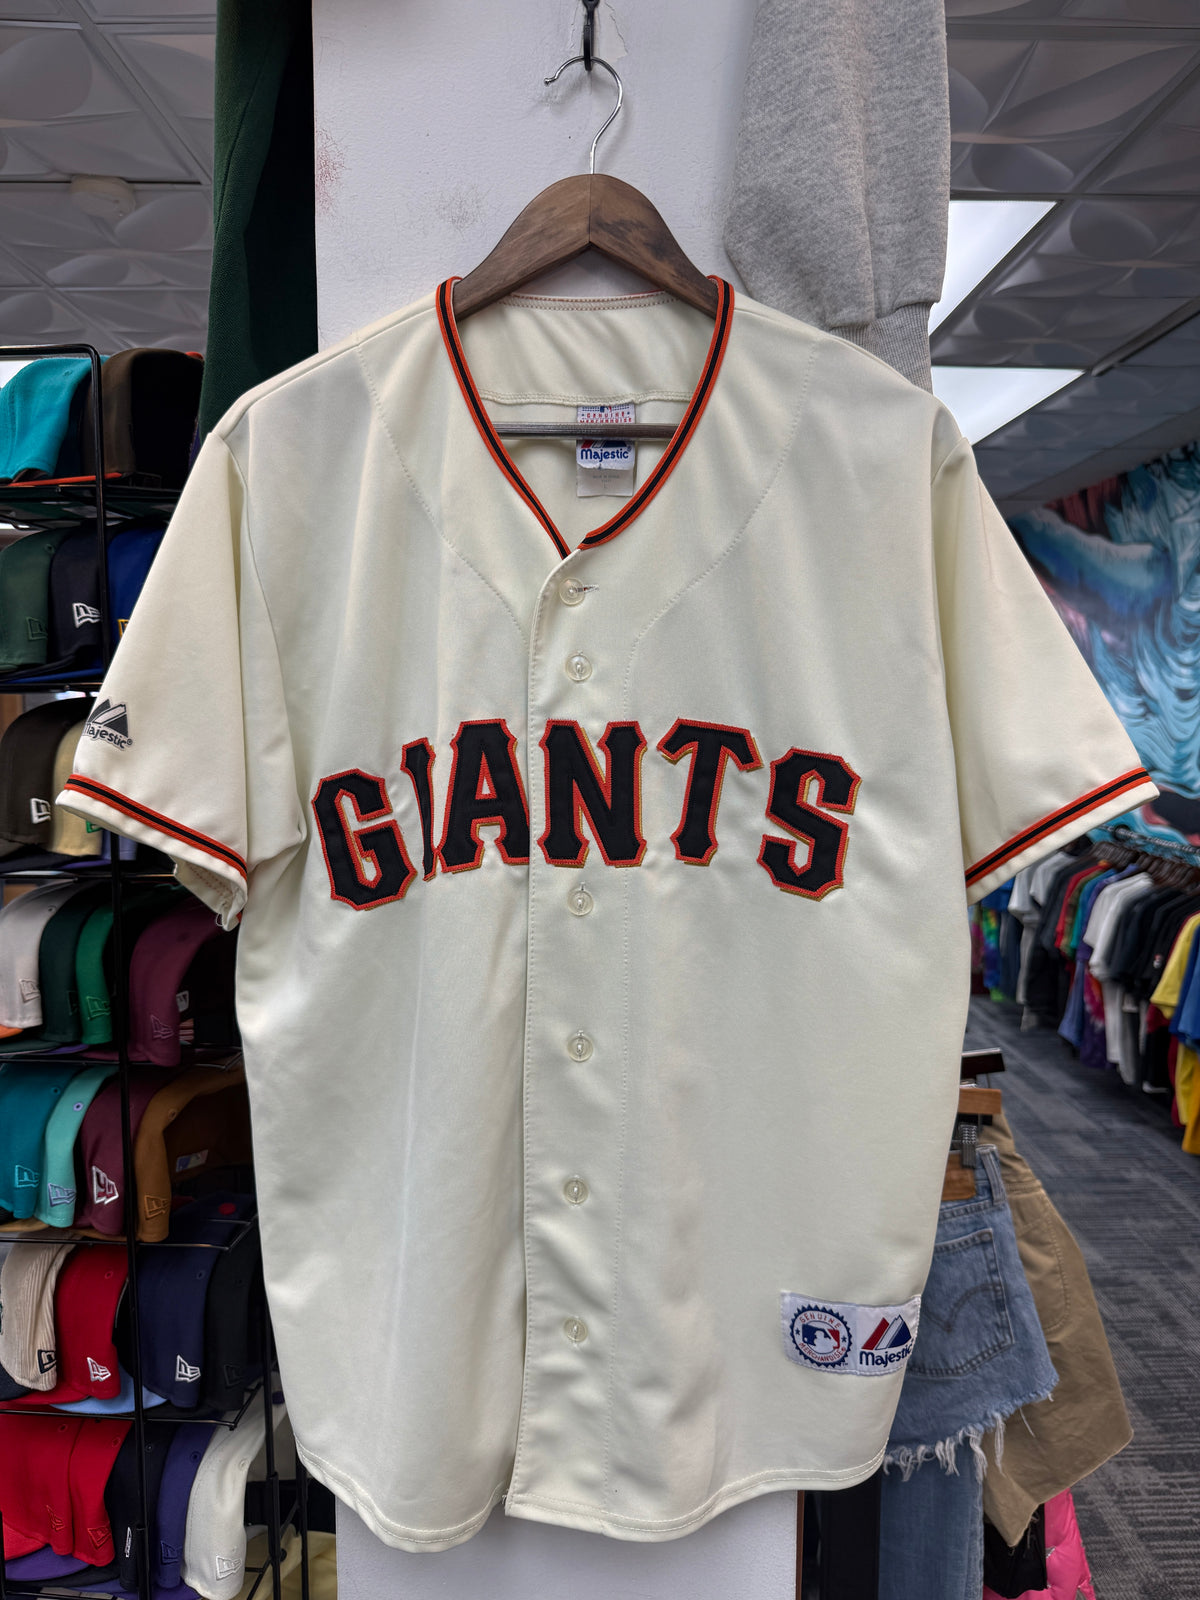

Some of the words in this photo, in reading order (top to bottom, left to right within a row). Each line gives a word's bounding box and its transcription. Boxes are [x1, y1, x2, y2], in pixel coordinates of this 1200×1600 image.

[580, 448, 629, 463] Majestic
[312, 718, 862, 911] GIANTS
[800, 1312, 843, 1330] GENUINE
[798, 1342, 845, 1362] MERCHANDISE
